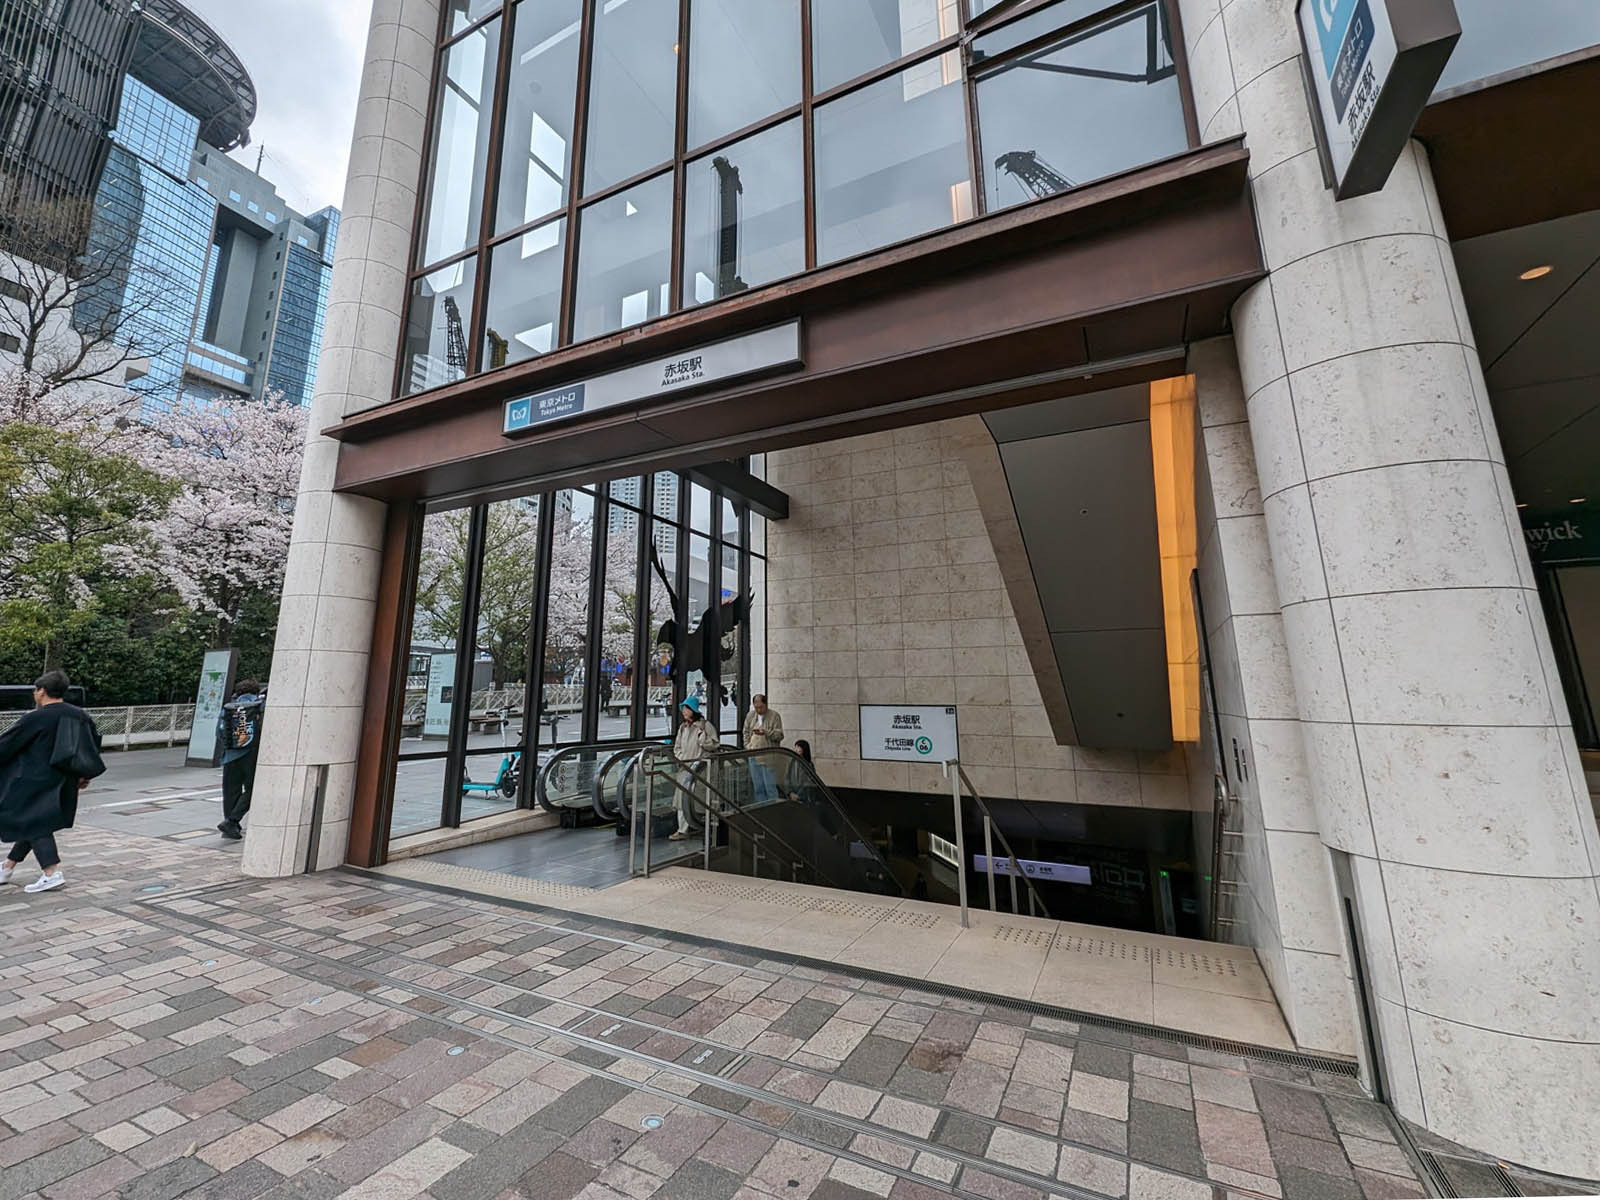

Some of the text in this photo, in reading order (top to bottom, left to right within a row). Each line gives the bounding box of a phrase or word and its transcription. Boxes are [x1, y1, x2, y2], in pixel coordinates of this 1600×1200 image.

[1348, 60, 1376, 135] 赤坂駅
[664, 356, 702, 378] 赤坂駅
[661, 374, 690, 387] Akasaka
[538, 391, 576, 410] 東京メトロ
[541, 407, 556, 417] Tokyo
[1524, 520, 1583, 541] wick
[893, 714, 920, 724] 赤坂駅
[884, 737, 914, 747] 千代田線
